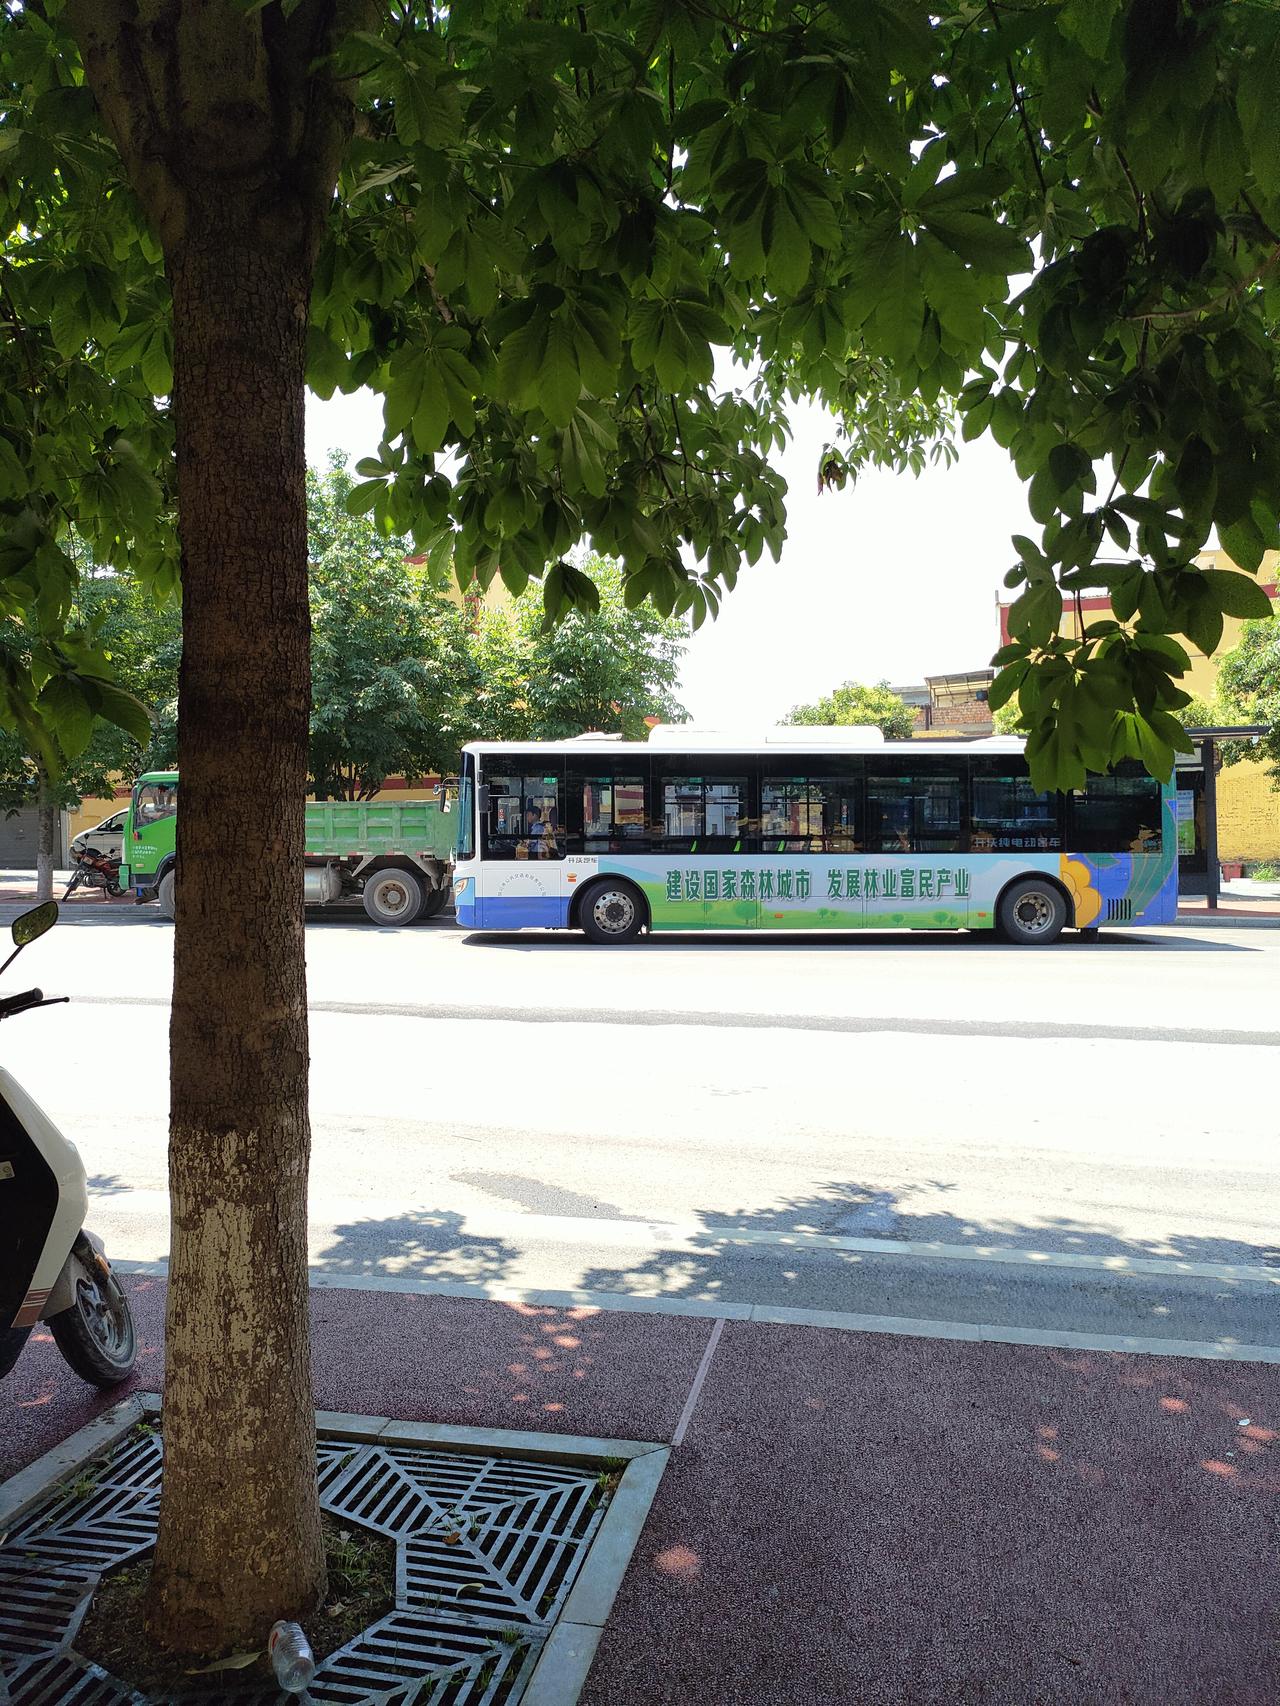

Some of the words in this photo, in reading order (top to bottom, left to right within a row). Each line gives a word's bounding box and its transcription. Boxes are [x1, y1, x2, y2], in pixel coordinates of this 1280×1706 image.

[666, 868, 811, 901] 建设国家森林城市
[827, 868, 970, 900] 发展林业富民产业
